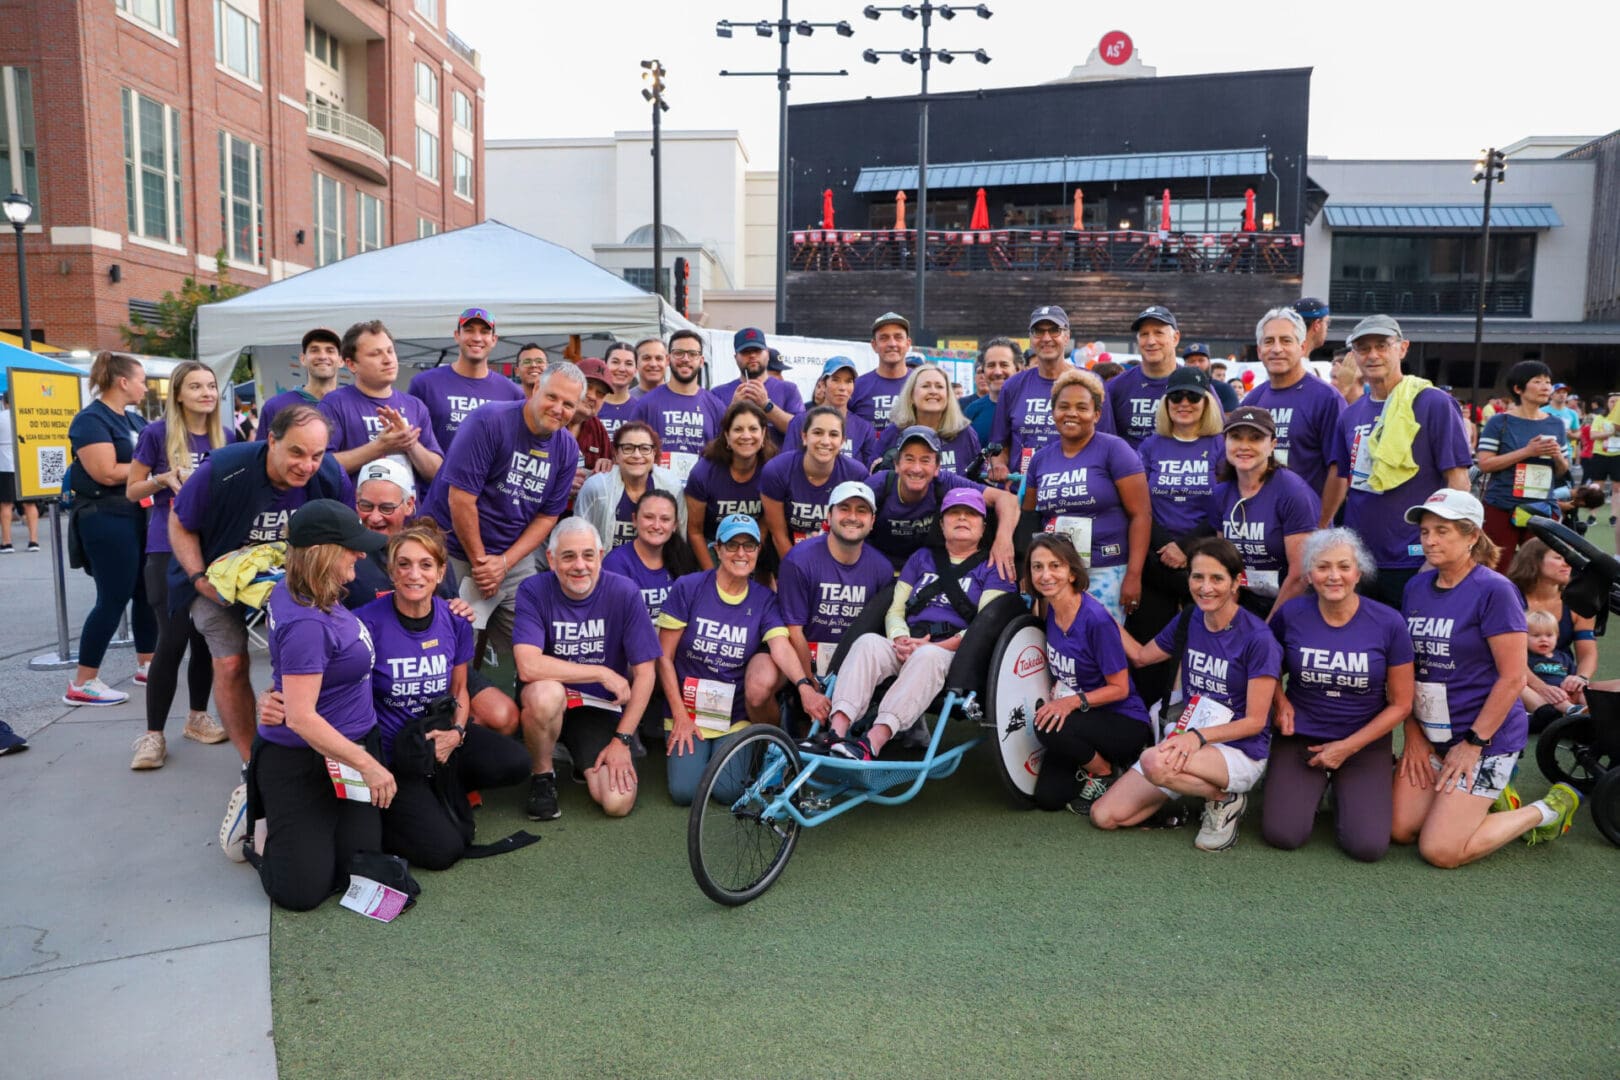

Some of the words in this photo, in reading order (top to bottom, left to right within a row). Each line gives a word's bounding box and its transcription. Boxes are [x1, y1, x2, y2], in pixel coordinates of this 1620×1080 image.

[794, 356, 805, 364] ART
[1026, 398, 1053, 413] TEA
[1130, 399, 1161, 414] TEA
[662, 410, 704, 426] TEAM
[1024, 415, 1046, 425] SUE
[1131, 416, 1152, 427] SUE
[665, 426, 683, 436] SUE
[685, 427, 703, 438] SUE
[511, 451, 551, 480] TEAM
[1158, 460, 1209, 474] TEAM
[506, 471, 523, 486] SUE
[523, 478, 546, 494] SUE
[1040, 468, 1087, 488] TEAM
[1158, 475, 1181, 486] SUE
[1184, 475, 1209, 486] SUE
[1037, 488, 1057, 501] SUE
[1061, 485, 1088, 497] SUE
[1180, 487, 1213, 496] Research
[717, 500, 761, 515] TEAM
[1058, 496, 1096, 507] Research
[253, 509, 298, 528] TEA
[249, 529, 277, 541] SUE
[1223, 520, 1265, 541] TEAM
[1244, 544, 1268, 555] SUE
[641, 586, 672, 605] TEA
[820, 582, 866, 603] TEAM
[818, 603, 840, 616] SUE
[552, 618, 605, 641] TEAM
[696, 616, 748, 645] TEAM
[1407, 616, 1455, 639] TEAM
[553, 643, 579, 656] SUE
[580, 640, 605, 655] SUE
[692, 639, 718, 654] SUE
[720, 644, 745, 659] SUE
[1426, 640, 1450, 657] SUE
[387, 654, 447, 679] TEAM
[1187, 648, 1229, 680] TEAM
[1300, 647, 1369, 673] TEAM
[391, 682, 420, 697] SUE
[423, 678, 447, 694] SUE
[1205, 679, 1229, 696] SUE
[1300, 671, 1333, 685] SUE
[1336, 674, 1369, 689] SUE
[1178, 703, 1196, 728] 1054
